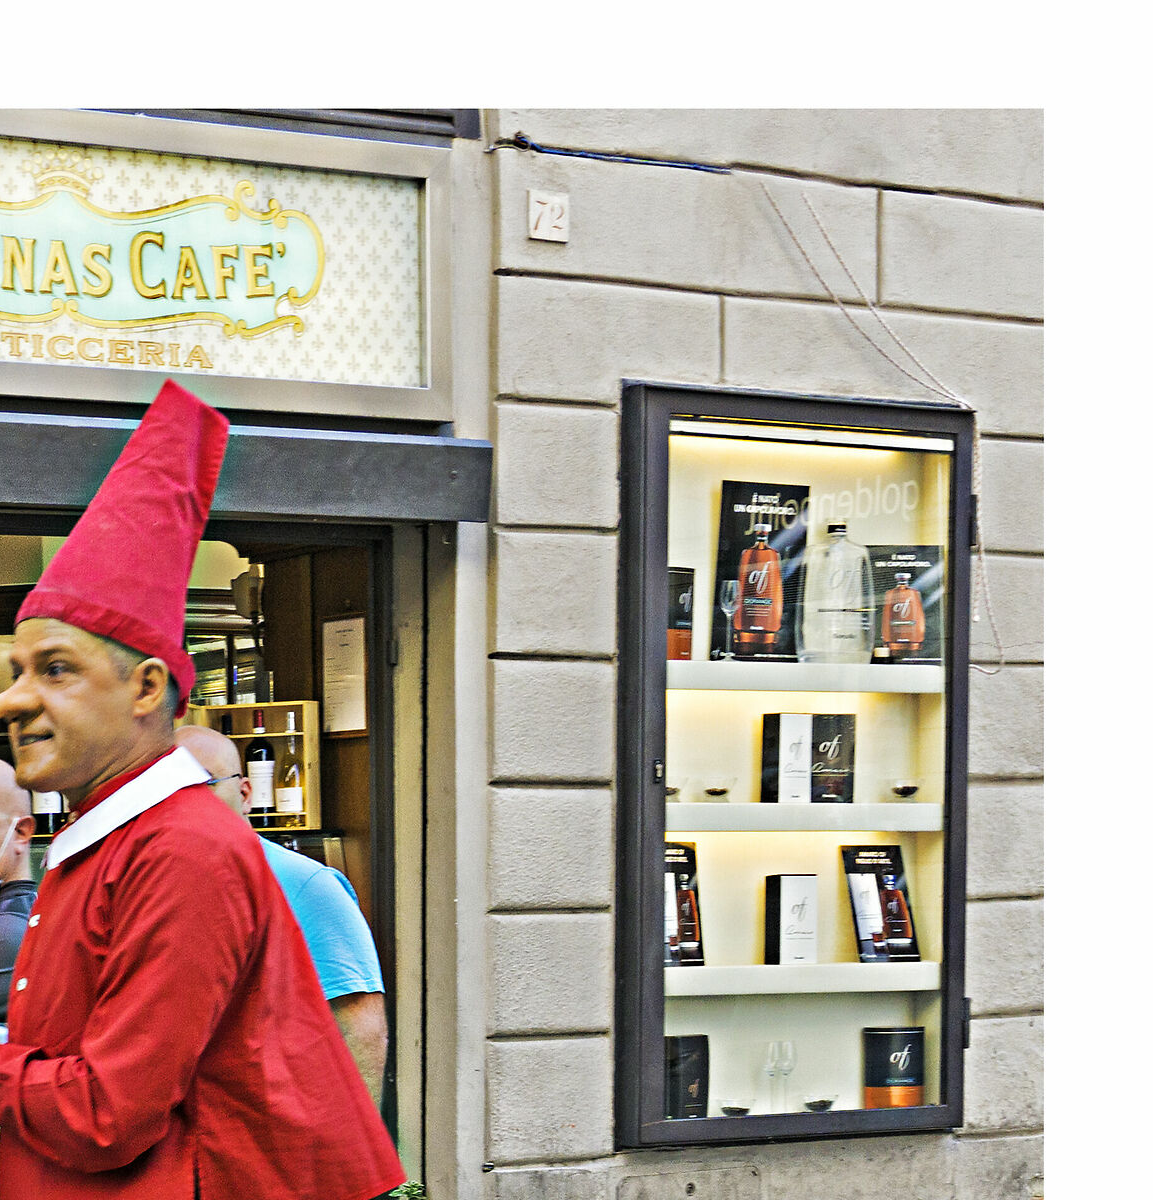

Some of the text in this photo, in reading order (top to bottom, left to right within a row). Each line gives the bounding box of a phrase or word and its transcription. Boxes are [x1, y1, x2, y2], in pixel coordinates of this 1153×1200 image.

[534, 199, 565, 231] 72
[129, 230, 286, 300] CAFE'
[819, 734, 842, 760] of
[889, 1044, 912, 1070] of
